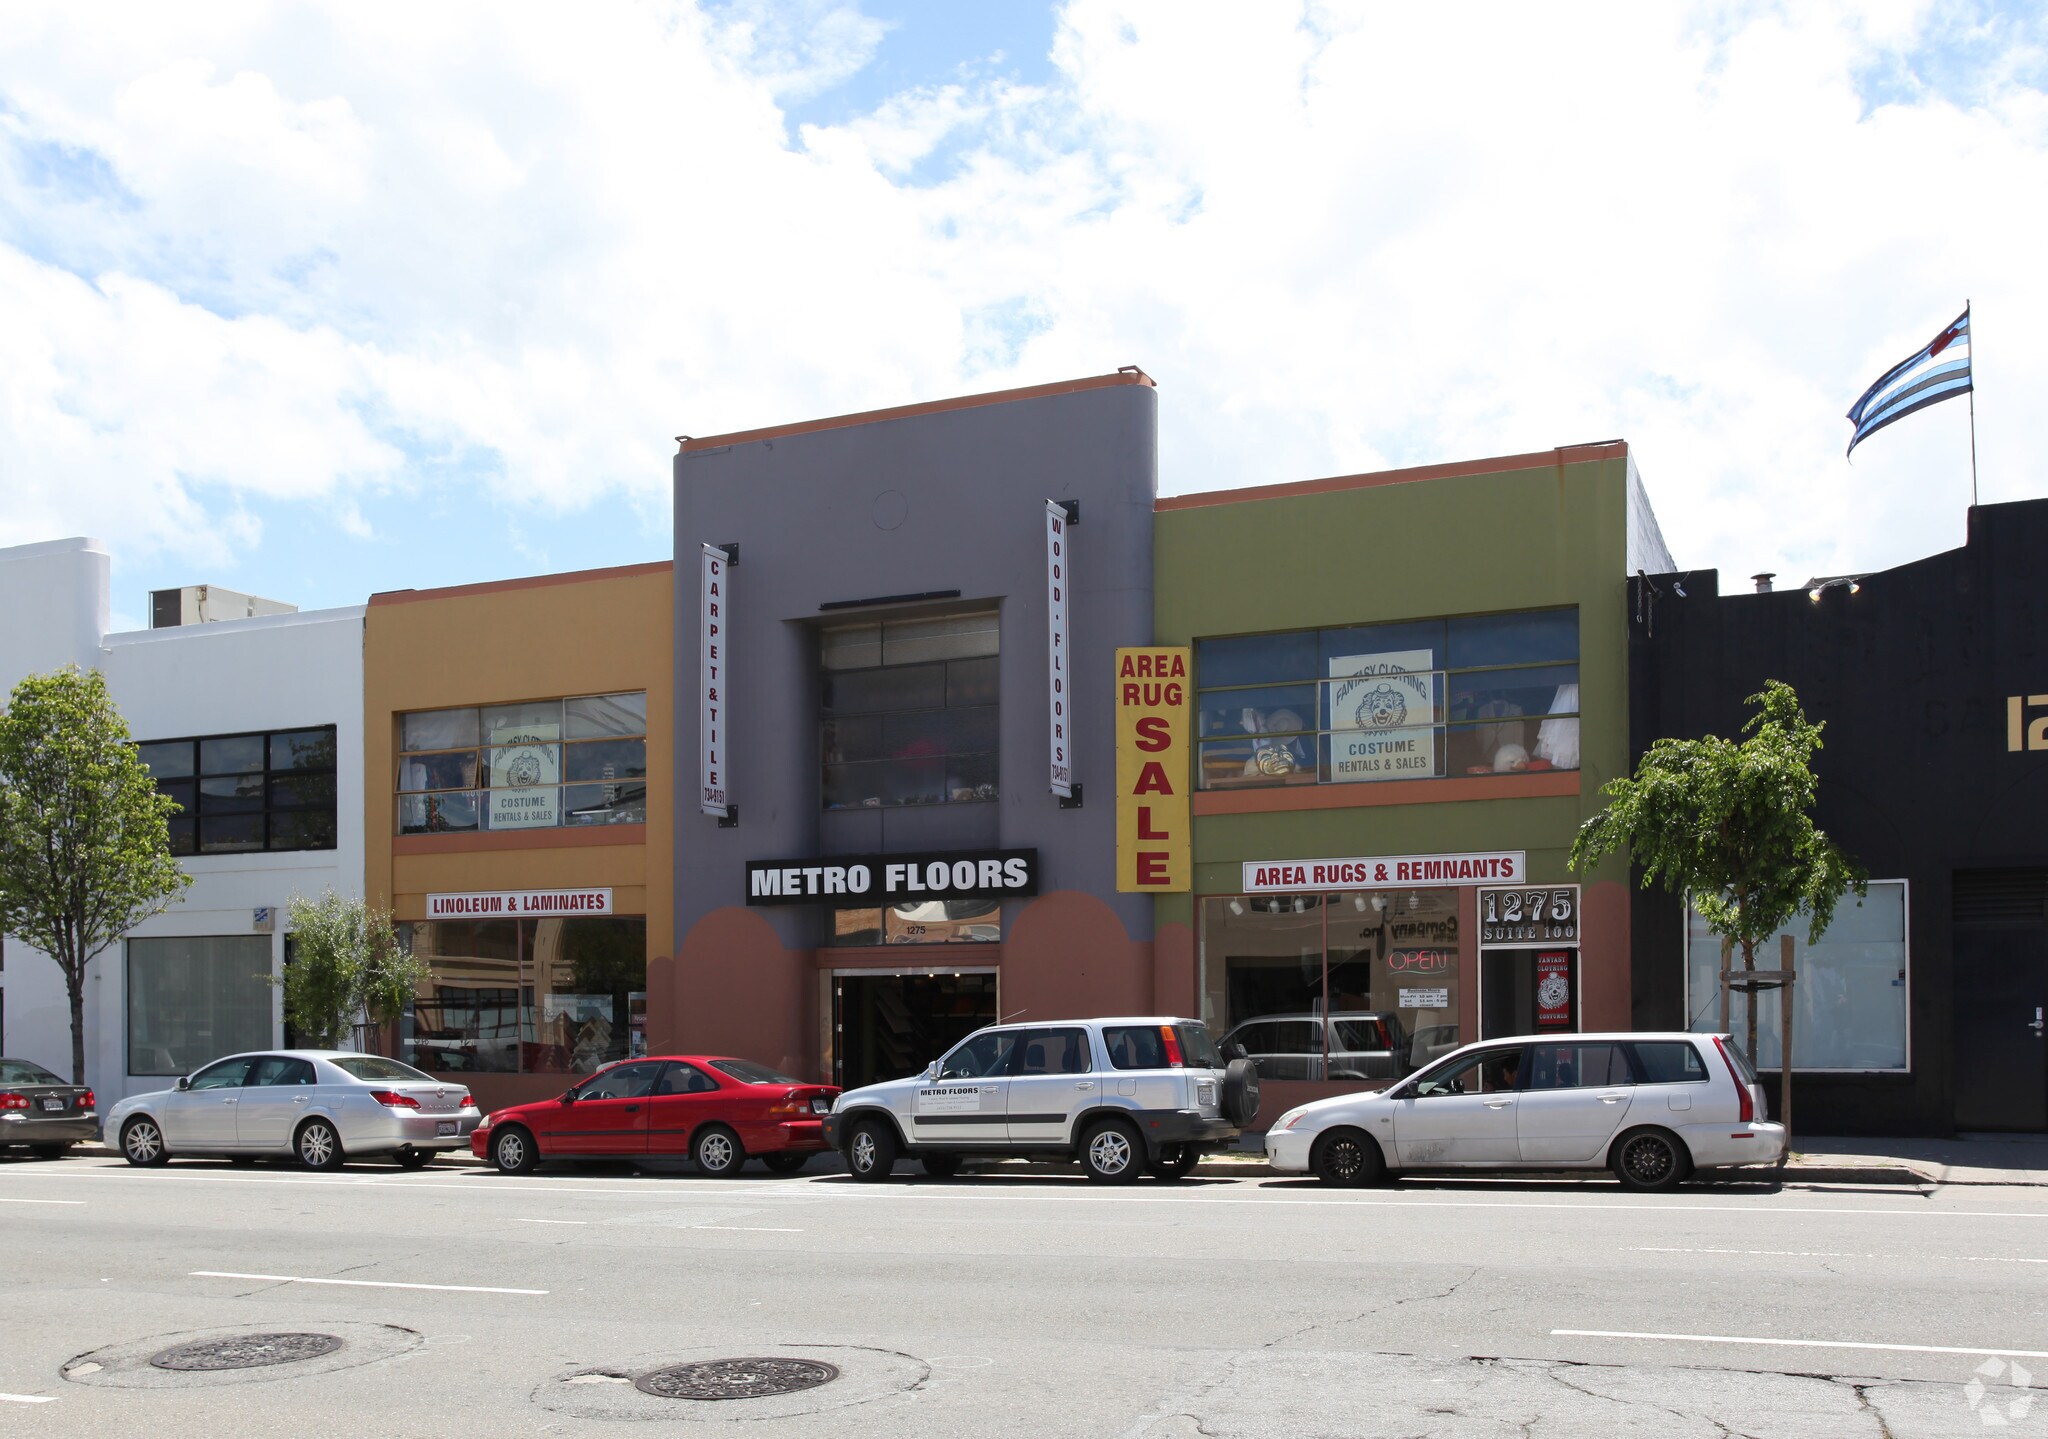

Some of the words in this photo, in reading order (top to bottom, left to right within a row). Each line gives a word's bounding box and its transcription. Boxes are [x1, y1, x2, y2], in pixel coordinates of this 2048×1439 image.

[1120, 655, 1186, 678] AREA
[1335, 663, 1376, 706] FANTASY
[1379, 663, 1427, 701] CLOTHING
[1123, 683, 1182, 706] RUG
[1348, 740, 1415, 756] COSTUME
[1338, 760, 1380, 773] RENTALS
[1384, 758, 1391, 770] &
[1396, 757, 1426, 769] SALES
[501, 796, 545, 808] COSTUME
[704, 787, 725, 804] 734-9151
[1133, 717, 1174, 885] SALE
[494, 811, 521, 822] RENTALS
[524, 812, 529, 820] &
[532, 810, 552, 820] SALES
[751, 864, 871, 897] METRO
[886, 858, 1028, 892] FLOORS
[1255, 866, 1306, 886] AREA
[1313, 863, 1366, 884] RUGS
[1374, 863, 1388, 881] &
[1397, 857, 1514, 881] REMNANTS
[433, 896, 502, 914] LINOLEUM
[507, 896, 517, 912] &
[524, 893, 605, 911] LAMINATES
[1484, 890, 1572, 922] 1275
[906, 925, 926, 935] 1275
[1484, 926, 1536, 940] SUITE
[1544, 925, 1574, 938] 100
[1389, 950, 1447, 970] OPEN
[1537, 964, 1568, 972] CLOTHING
[949, 1087, 979, 1095] FLOORS
